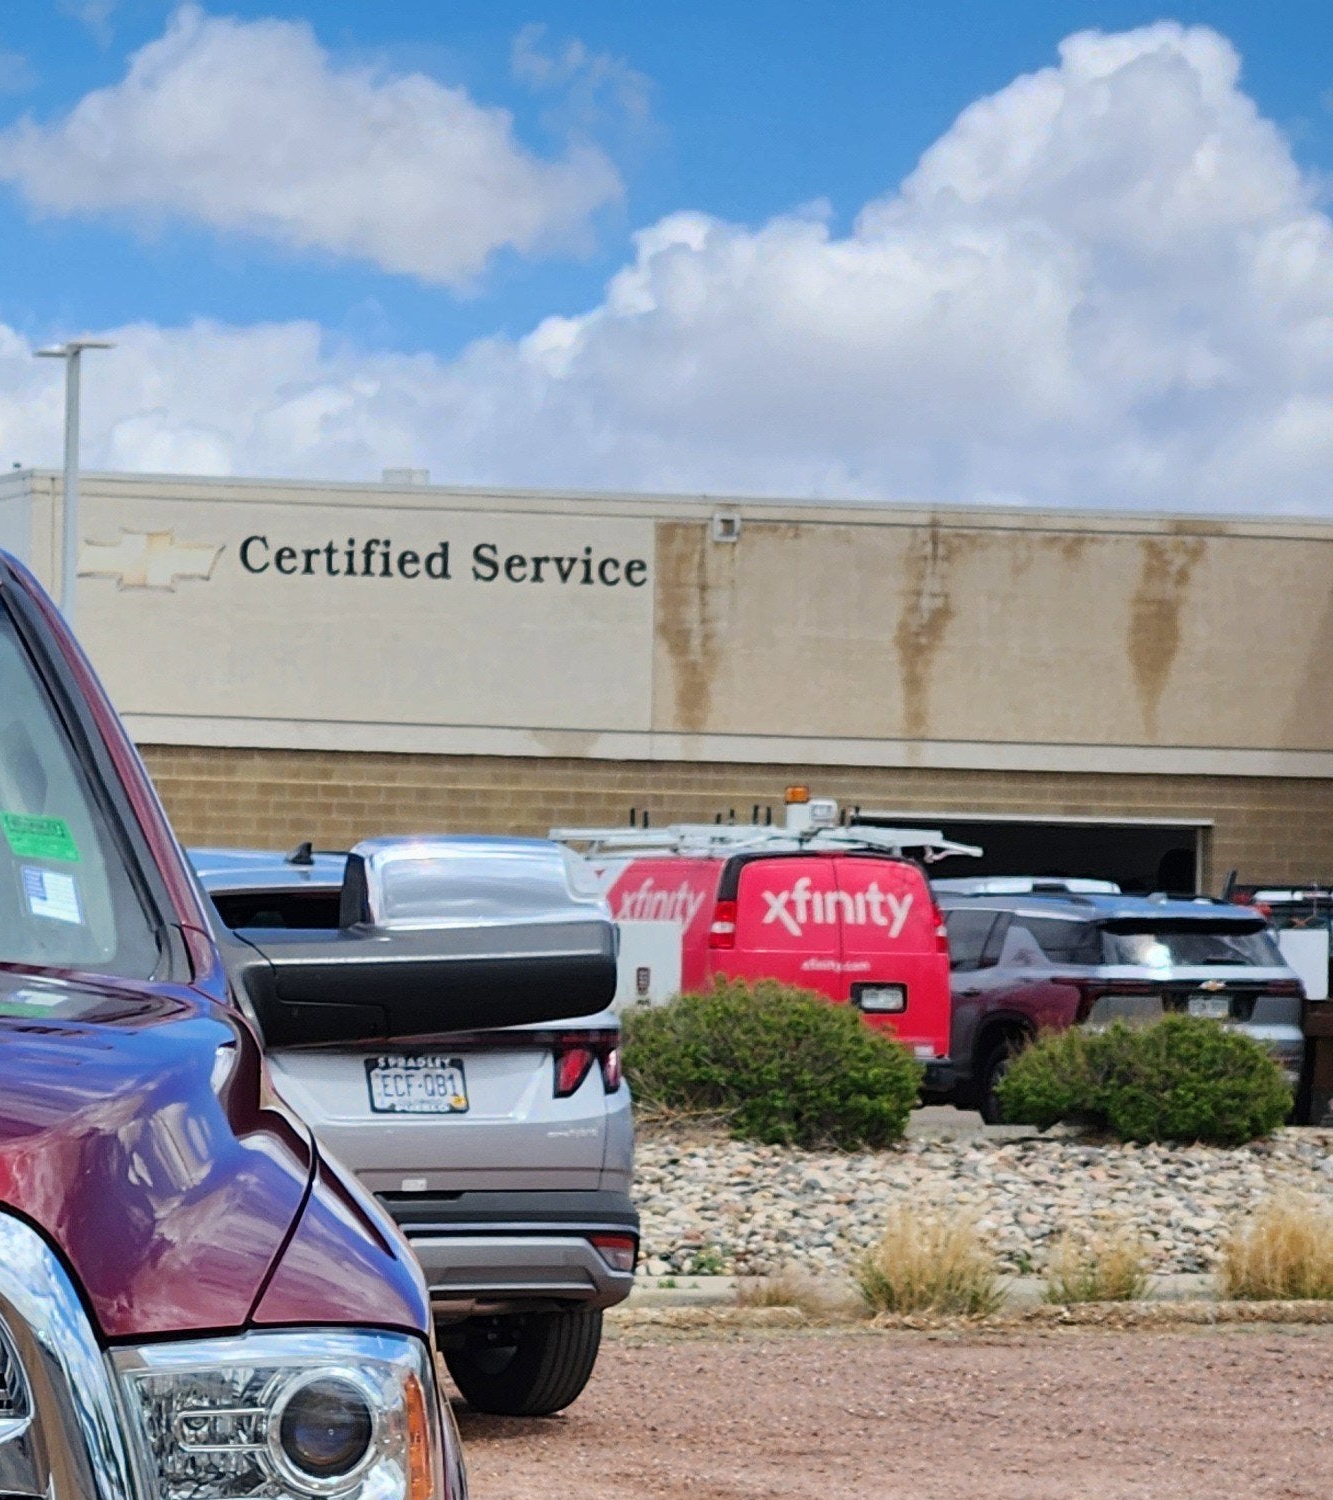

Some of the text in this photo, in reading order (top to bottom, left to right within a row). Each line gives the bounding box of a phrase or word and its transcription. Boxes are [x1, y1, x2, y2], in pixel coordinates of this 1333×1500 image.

[239, 535, 648, 587] Certified Service
[761, 877, 914, 938] xfinity
